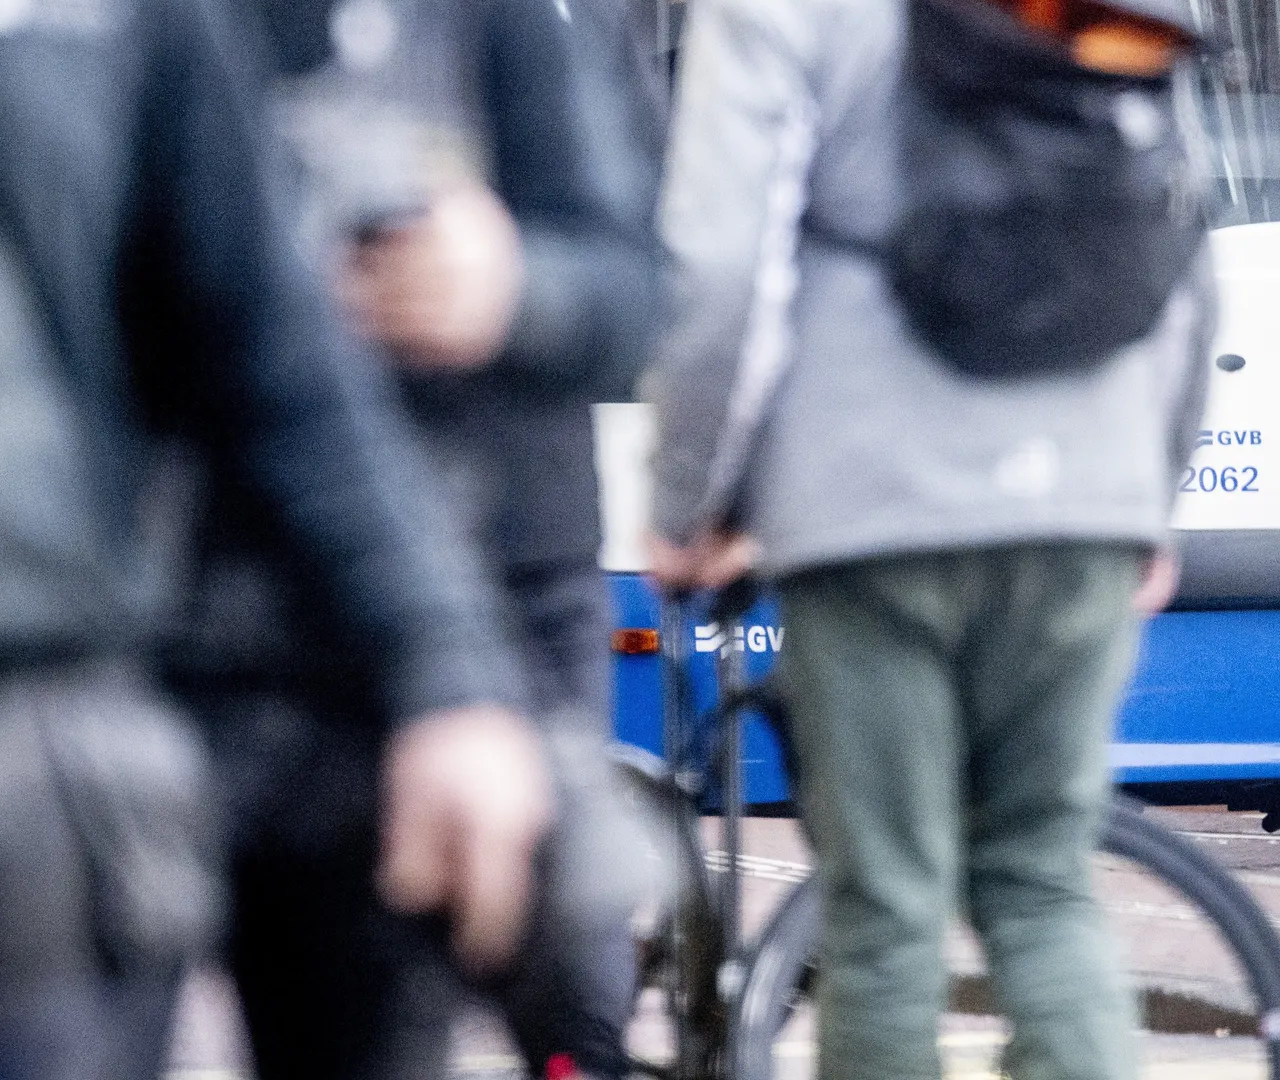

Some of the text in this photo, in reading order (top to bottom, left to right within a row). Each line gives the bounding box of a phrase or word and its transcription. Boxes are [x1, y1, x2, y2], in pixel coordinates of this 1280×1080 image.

[1217, 429, 1263, 446] GVB
[1179, 465, 1260, 493] 2062
[746, 625, 786, 653] GV
